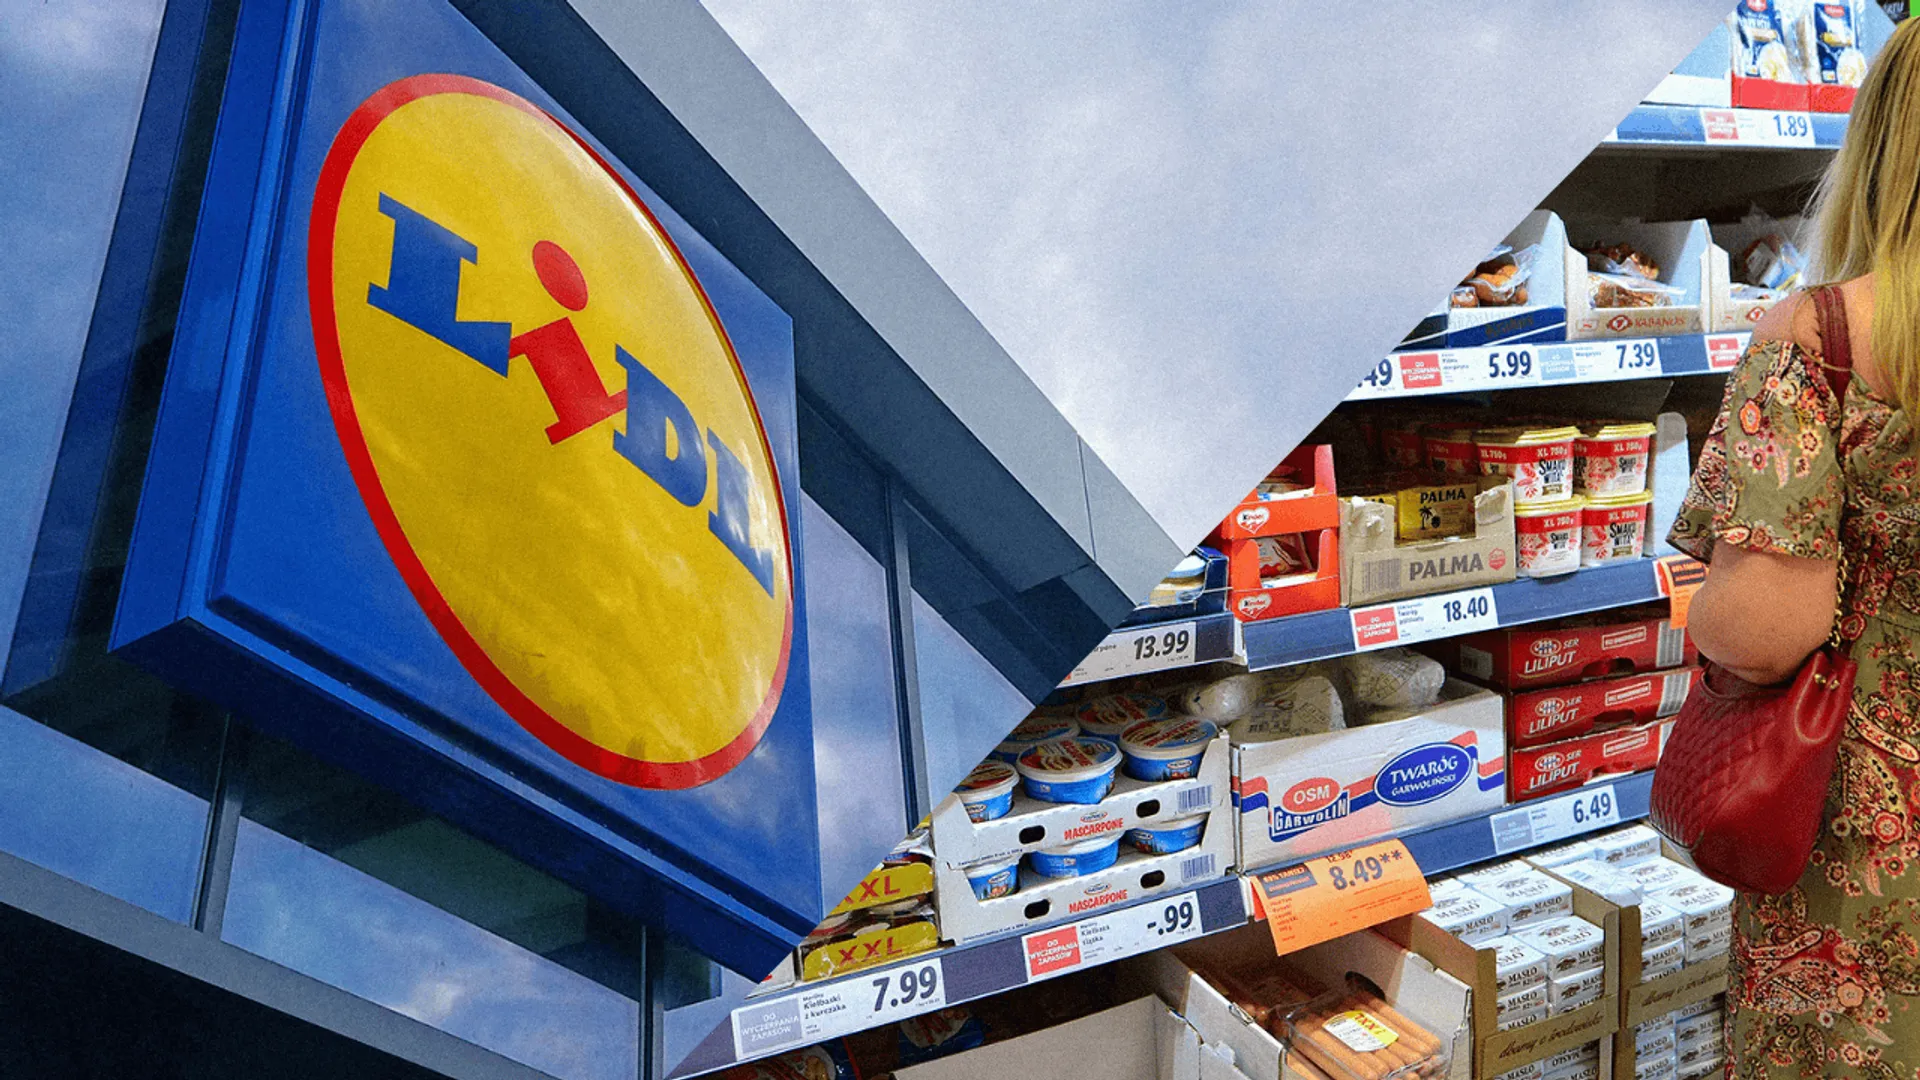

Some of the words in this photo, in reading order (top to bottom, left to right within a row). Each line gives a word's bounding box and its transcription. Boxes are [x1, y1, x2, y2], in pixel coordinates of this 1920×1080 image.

[1773, 114, 1808, 137] 1.89
[1488, 350, 1532, 378] 5.99
[1616, 342, 1655, 369] 7.39
[1420, 488, 1466, 504] PALMA
[1409, 552, 1484, 581] PALMA
[1443, 595, 1488, 622] 18.40
[1134, 630, 1190, 660] 13.99
[1563, 638, 1580, 650] SER
[1525, 650, 1576, 674] LILIPUT
[1529, 708, 1579, 735] LILIPUT
[1390, 755, 1458, 784] TWARÓG
[1529, 761, 1580, 790] LILIPUT
[1293, 785, 1330, 805] OSM
[1391, 773, 1457, 797] GARWOLIŃSKI
[1274, 797, 1348, 831] GARWOLIN
[1573, 791, 1611, 823] 6.49
[1064, 818, 1123, 840] MASCARPONE
[1068, 889, 1128, 913] MASCARPONE
[1534, 896, 1563, 909] MASŁO
[1466, 916, 1495, 930] MASŁO
[839, 937, 902, 966] XXL
[1508, 966, 1538, 981] MASŁO
[872, 966, 937, 1012] 7.99
[1508, 990, 1538, 1006] MASŁO
[763, 1013, 777, 1022] DO
